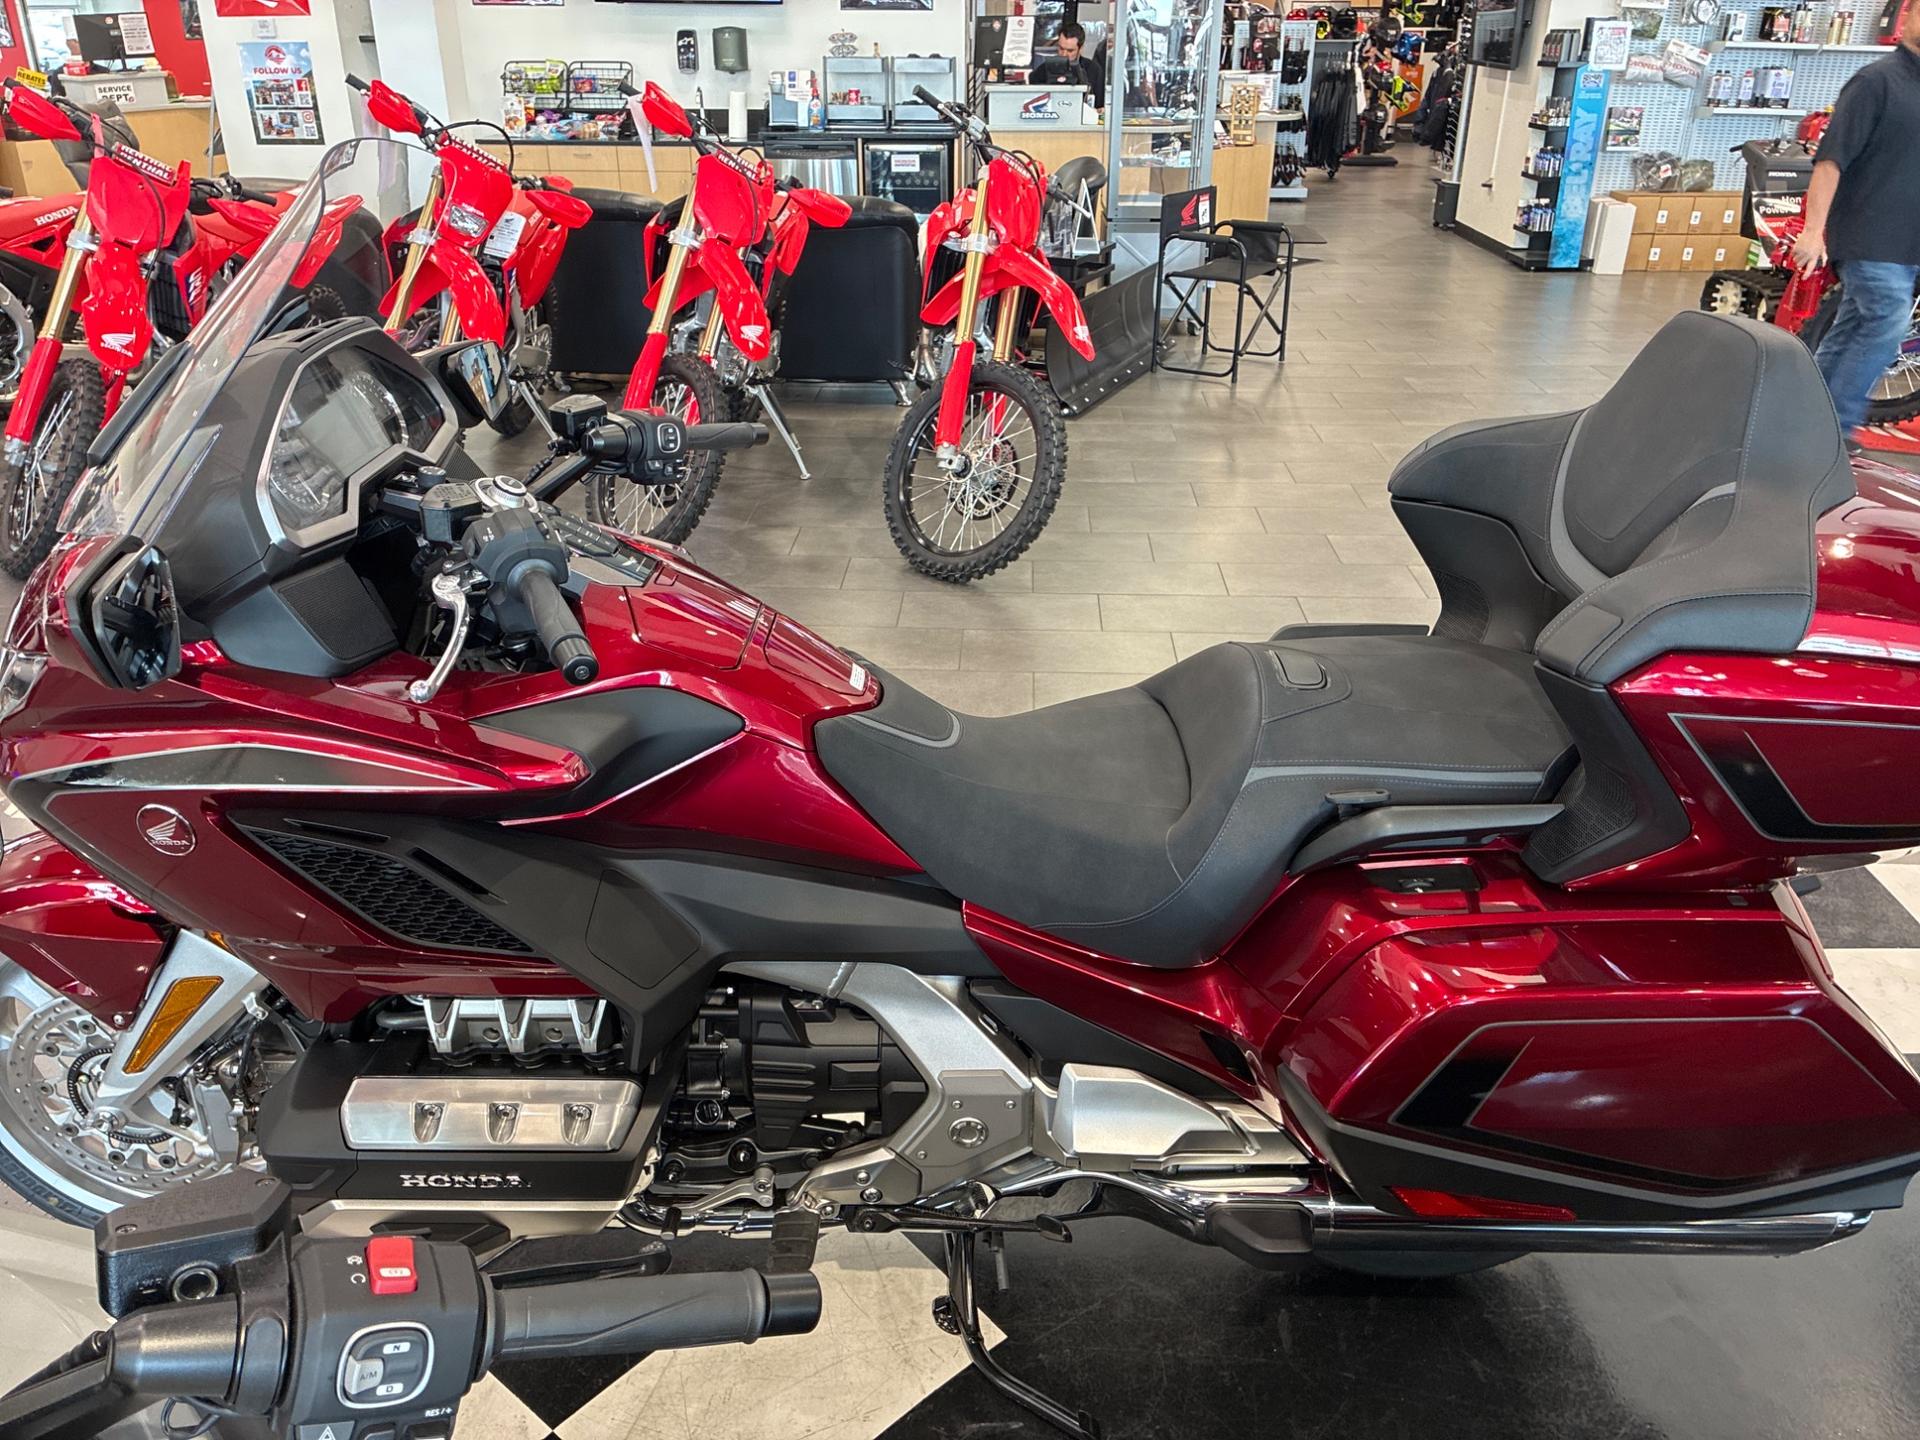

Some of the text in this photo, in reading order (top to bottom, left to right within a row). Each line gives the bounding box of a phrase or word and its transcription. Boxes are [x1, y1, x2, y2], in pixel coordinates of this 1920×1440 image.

[253, 67, 303, 75] FOLLOW US
[98, 84, 132, 94] SERVICE
[1767, 170, 1798, 178] HONDA
[33, 205, 79, 227] HONDA
[399, 1173, 532, 1189] HONDA
[358, 1370, 378, 1381] A/M
